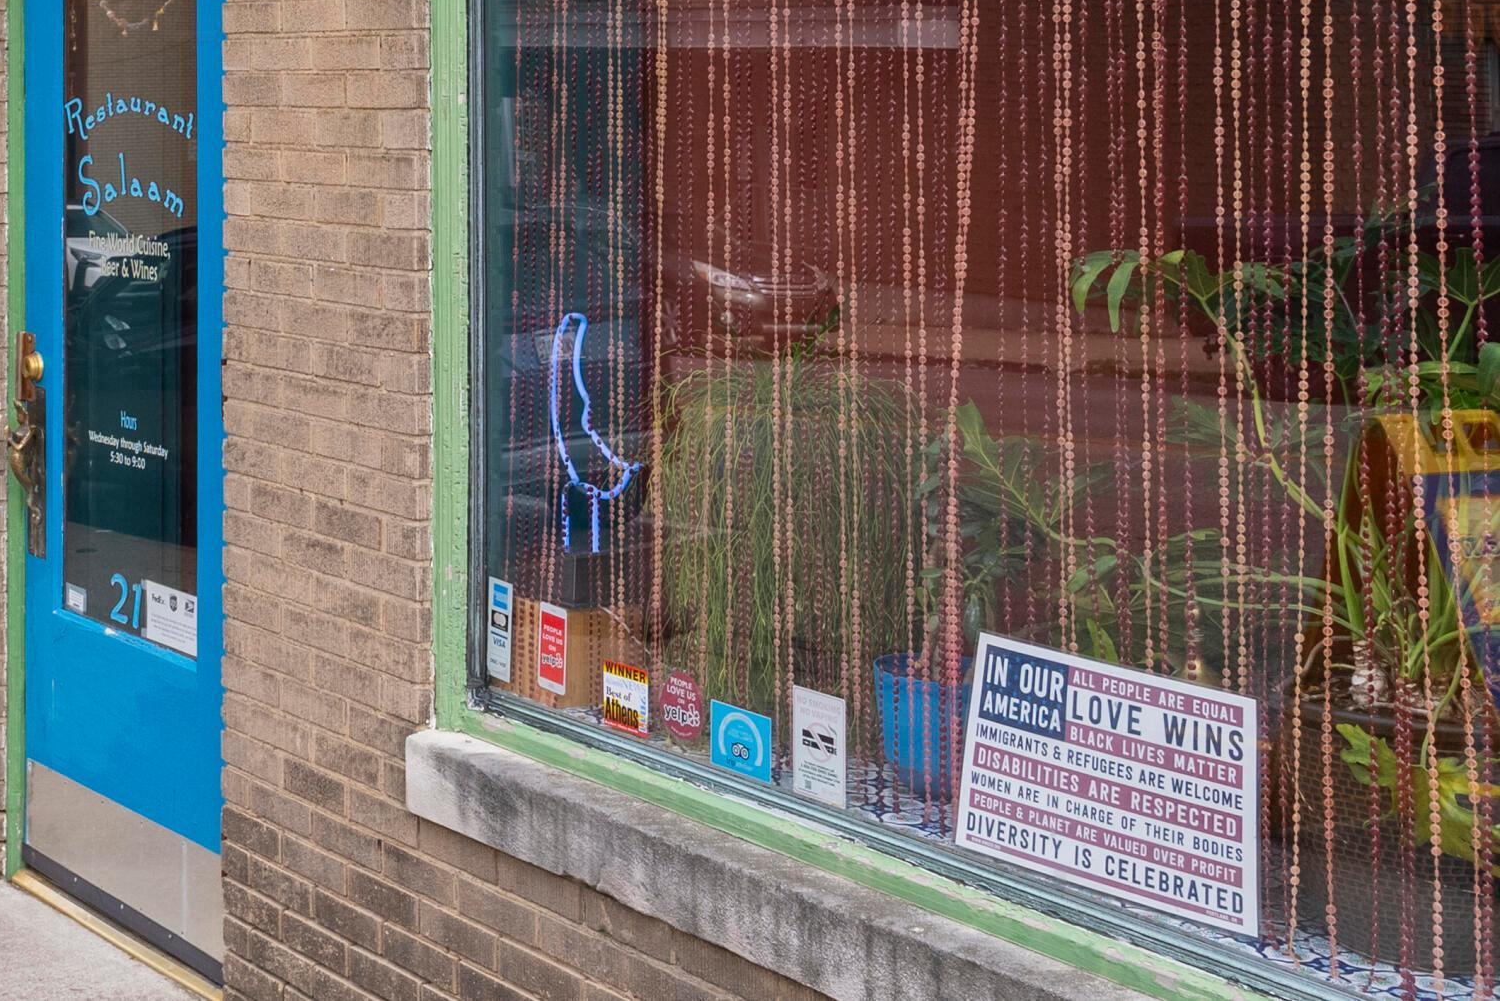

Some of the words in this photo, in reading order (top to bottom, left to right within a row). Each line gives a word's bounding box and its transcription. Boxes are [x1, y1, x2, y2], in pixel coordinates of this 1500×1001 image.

[65, 92, 195, 140] Restaurant
[78, 152, 185, 218] Salaam
[88, 230, 106, 248] Fine
[106, 232, 135, 253] World
[137, 234, 171, 260] Cuisine,
[100, 256, 120, 276] Beer
[121, 258, 130, 278] &
[130, 258, 158, 281] Wines
[88, 429, 120, 449] Wednesday
[120, 437, 142, 454] through
[143, 441, 169, 460] Saturday
[110, 573, 142, 629] 21
[493, 636, 506, 648] VISA
[542, 633, 555, 643] LOVE
[543, 624, 562, 636] PEOPLE
[604, 660, 646, 684] WINNER
[606, 686, 621, 699] Best
[624, 693, 632, 701] of
[666, 684, 685, 698] LOVE
[686, 691, 696, 701] US
[670, 677, 692, 690] PEOPLE
[986, 653, 1009, 688] IN
[1019, 663, 1064, 703] OUR
[605, 697, 639, 729] Athens
[663, 704, 689, 726] yelp
[983, 690, 1061, 733] AMERICA
[1072, 670, 1095, 688] ALL
[1102, 677, 1151, 702] PEOPLE
[1158, 691, 1184, 710] ARE
[1192, 700, 1237, 723] EQUAL
[1071, 690, 1142, 736] LOVE
[1163, 712, 1244, 761] WINS
[975, 723, 1048, 757] IMMIGRANTS
[1053, 745, 1061, 761] &
[1067, 749, 1133, 780] REFUGEES
[1139, 769, 1165, 789] ARE
[1171, 777, 1243, 810] WELCOME
[1070, 725, 1113, 752] BLACK
[1122, 740, 1165, 765] LIVES
[1173, 753, 1237, 784] MATTER
[977, 747, 1080, 793] DISABILITIES
[1088, 780, 1121, 805] ARE
[1131, 791, 1237, 838] RESPECTED
[971, 770, 1011, 795] WOMEN
[1018, 786, 1040, 804] ARE
[1047, 794, 1059, 809] IN
[1066, 800, 1113, 826] CHARGE
[1121, 816, 1137, 831] OF
[1145, 822, 1185, 846] THEIR
[1193, 836, 1243, 862] BODIES
[974, 793, 1012, 815] PEOPLE
[1015, 806, 1024, 820] &
[1028, 811, 1071, 834] PLANET
[1075, 825, 1098, 842] ARE
[1103, 832, 1147, 857] VALUED
[1153, 848, 1185, 869] OVER
[1191, 858, 1237, 883] PROFIT
[967, 811, 1062, 859] DIVERSITY
[1074, 846, 1092, 869] IS
[1105, 855, 1243, 914] CELEBRATED
